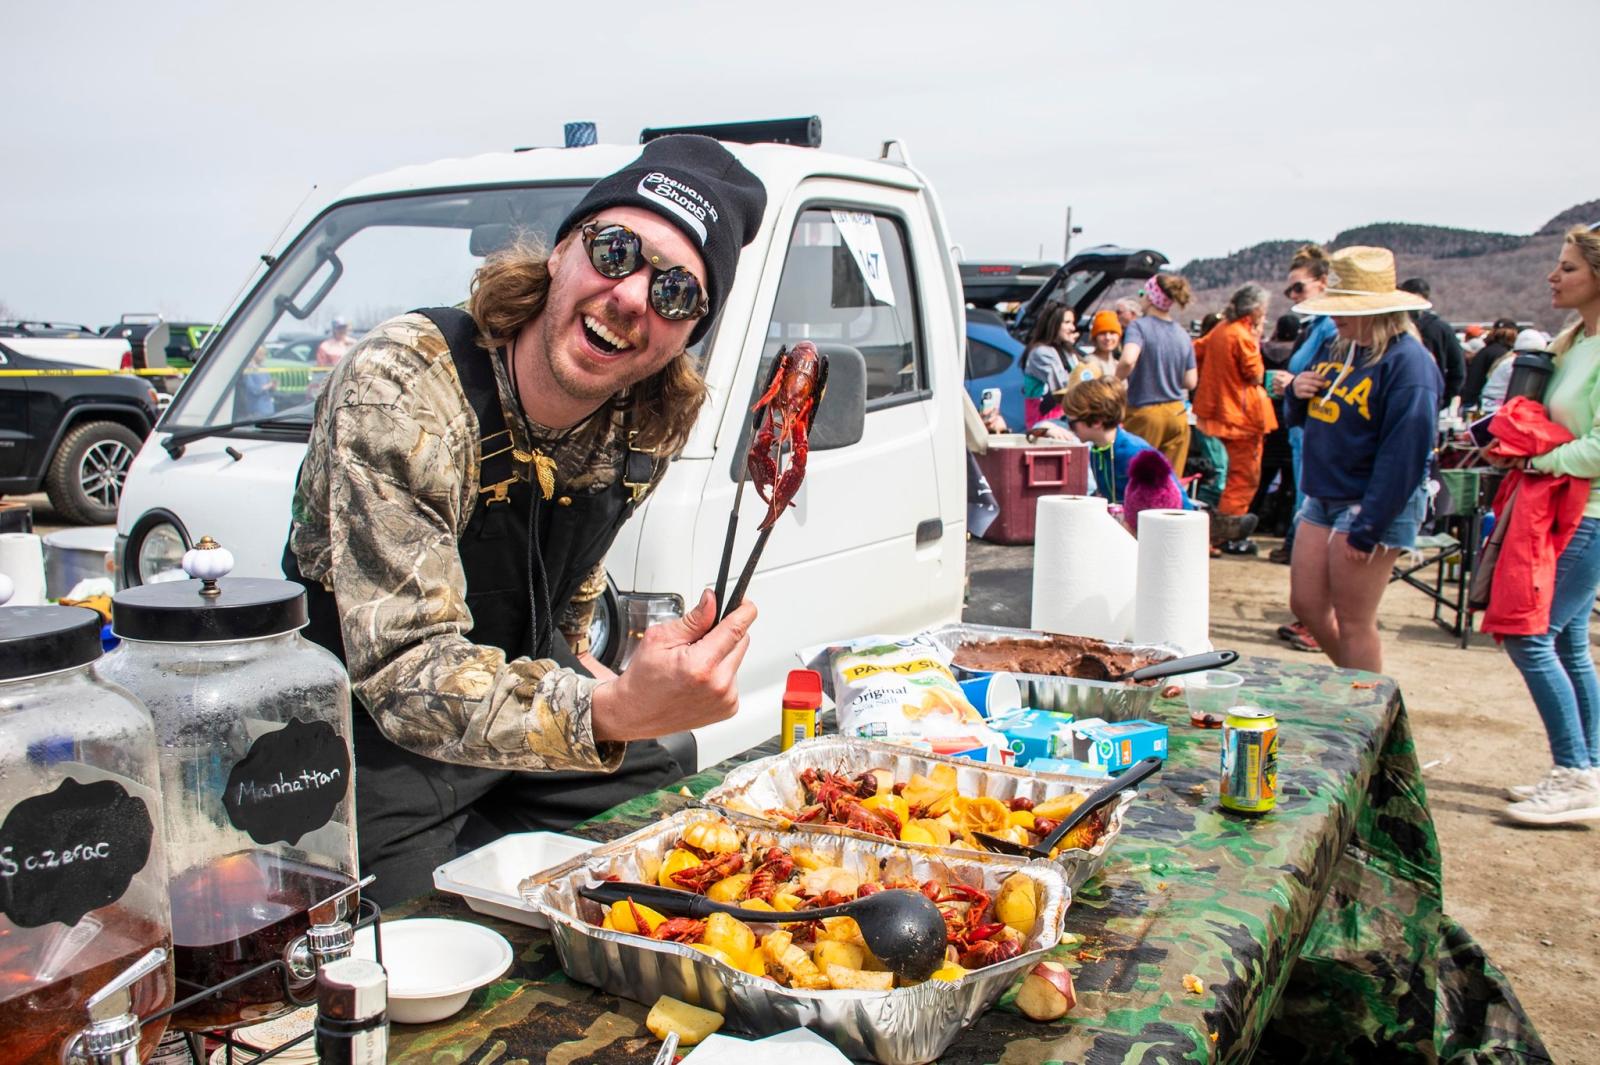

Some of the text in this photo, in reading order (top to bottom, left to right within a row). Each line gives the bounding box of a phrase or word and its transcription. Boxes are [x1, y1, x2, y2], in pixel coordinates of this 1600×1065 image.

[654, 184, 707, 221] Shops
[852, 686, 908, 706] Original
[238, 767, 341, 806] Manhattan
[0, 841, 110, 877] Sazerac
